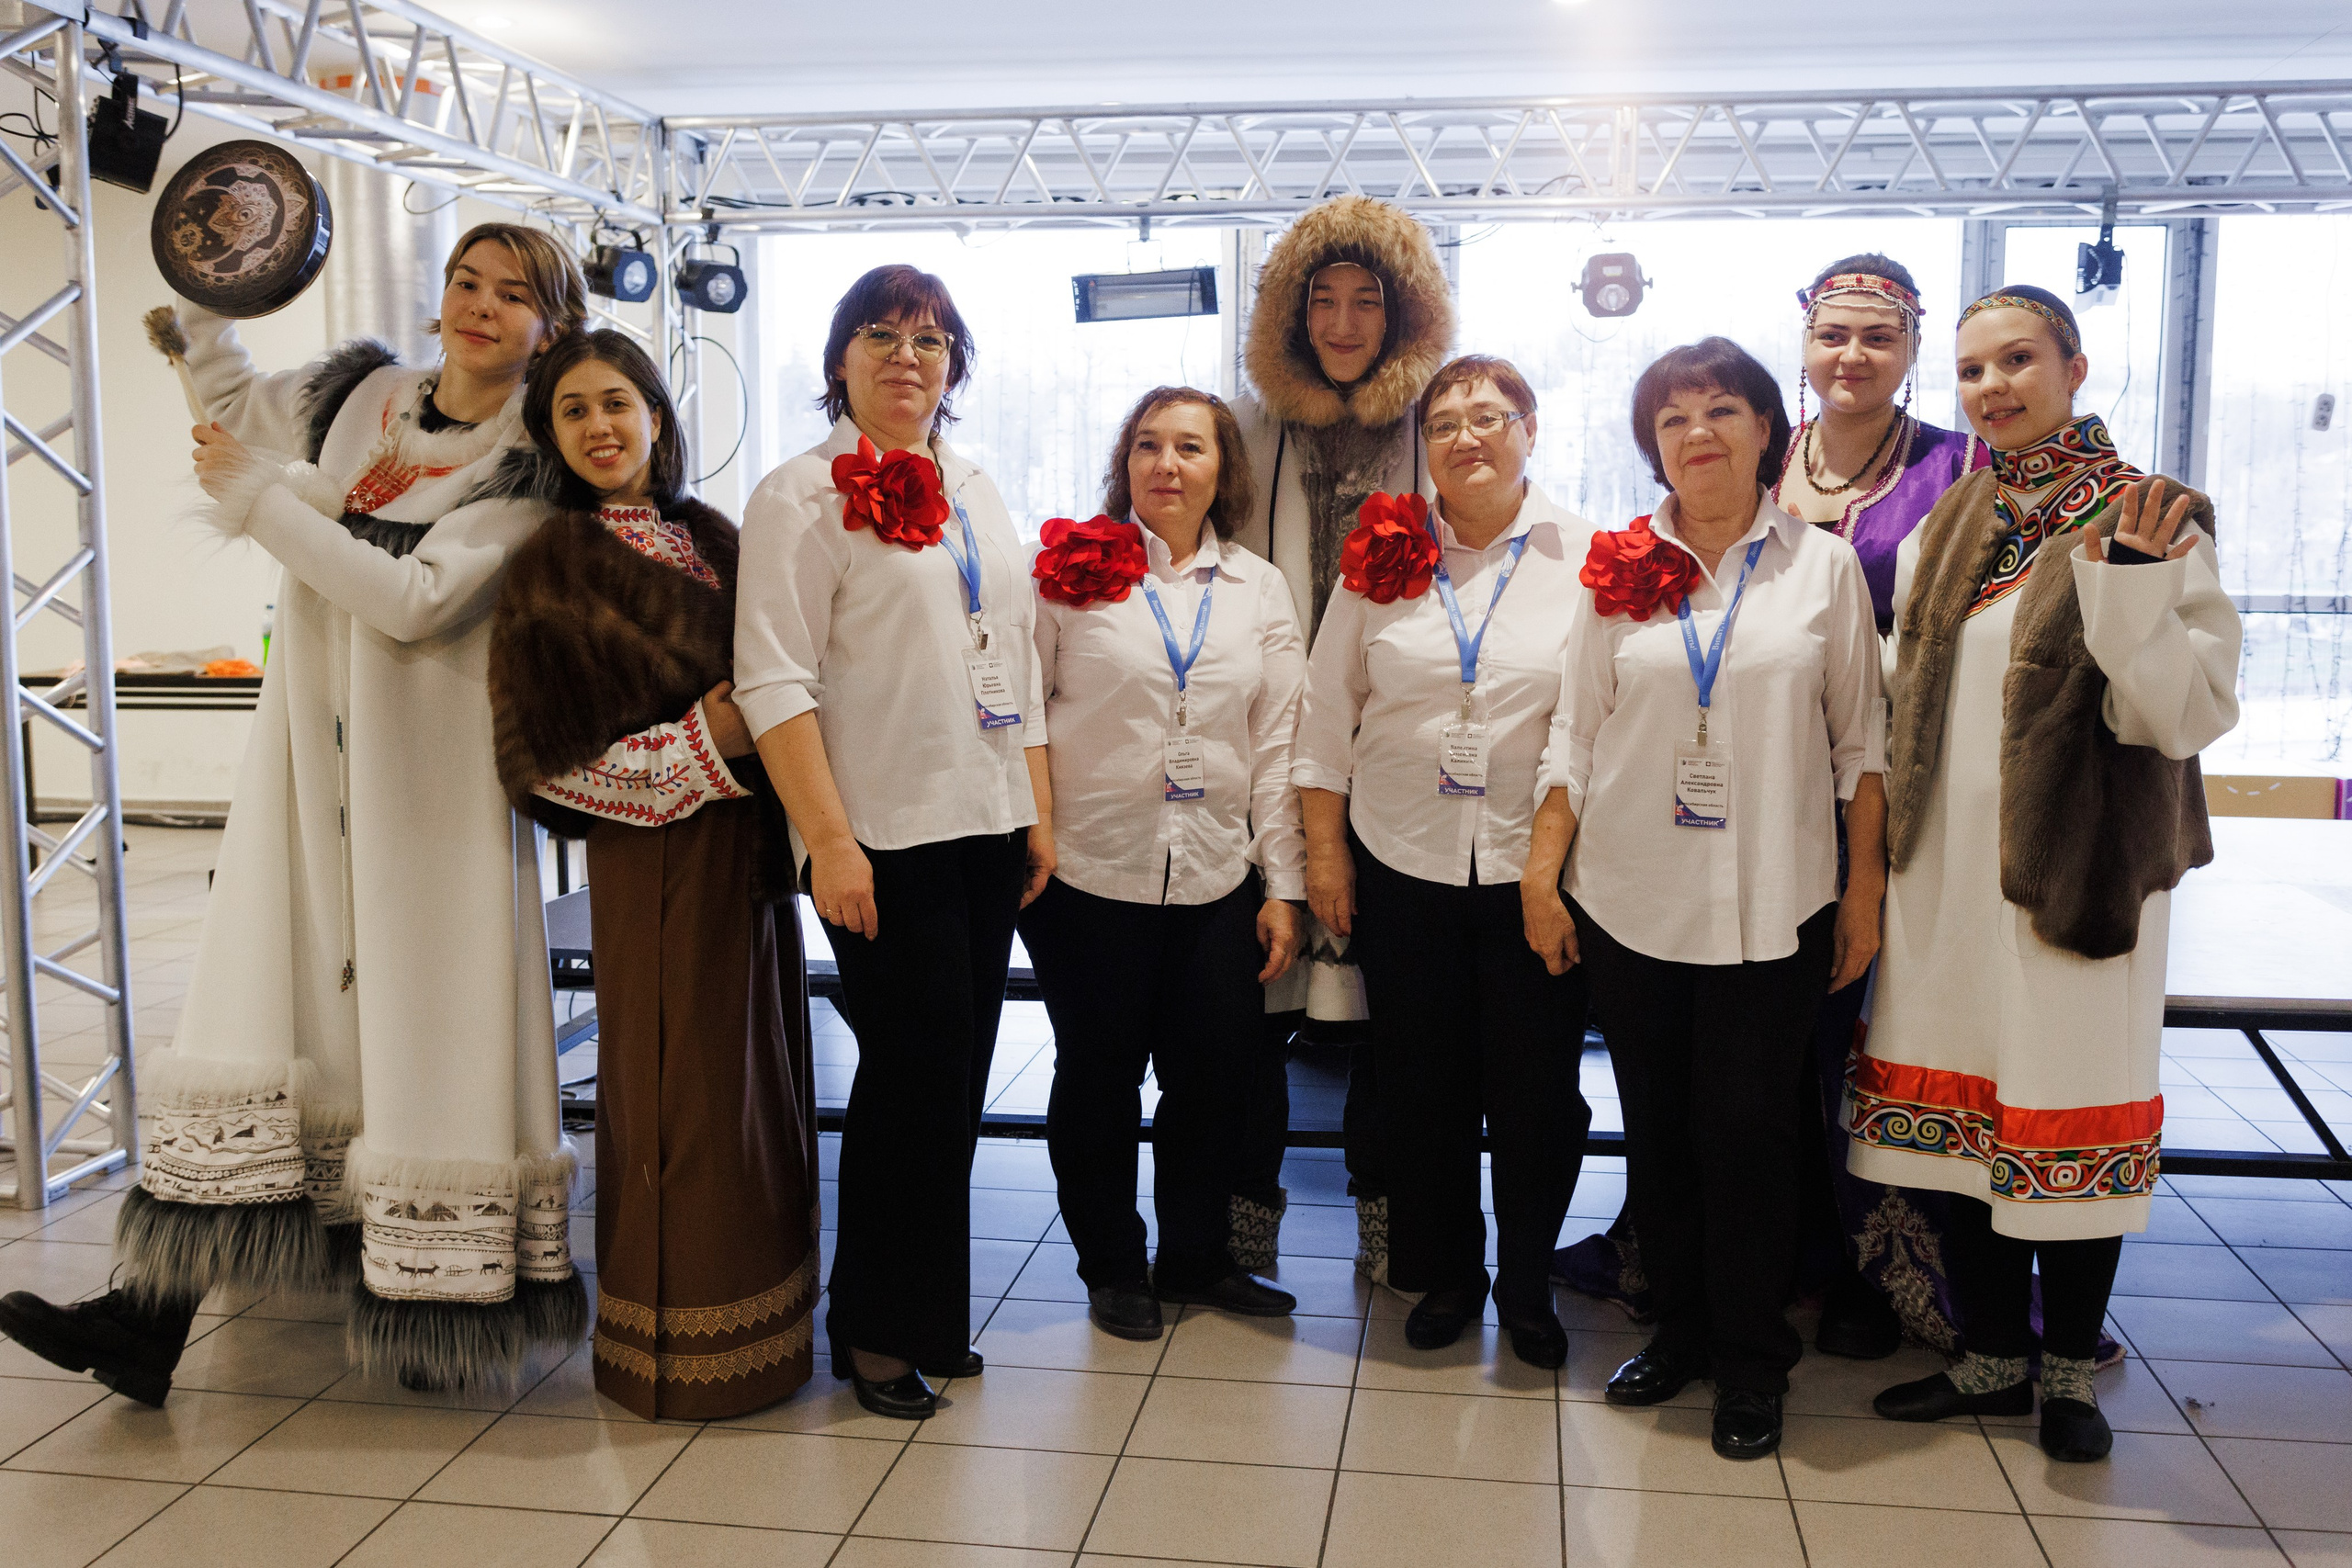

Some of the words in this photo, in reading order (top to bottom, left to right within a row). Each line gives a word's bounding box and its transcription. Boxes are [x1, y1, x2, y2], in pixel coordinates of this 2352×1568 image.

[1711, 626, 1725, 650] Виват,
[986, 717, 1016, 728] УЧАСТНИК
[1170, 791, 1199, 799] УЧАСТНИК
